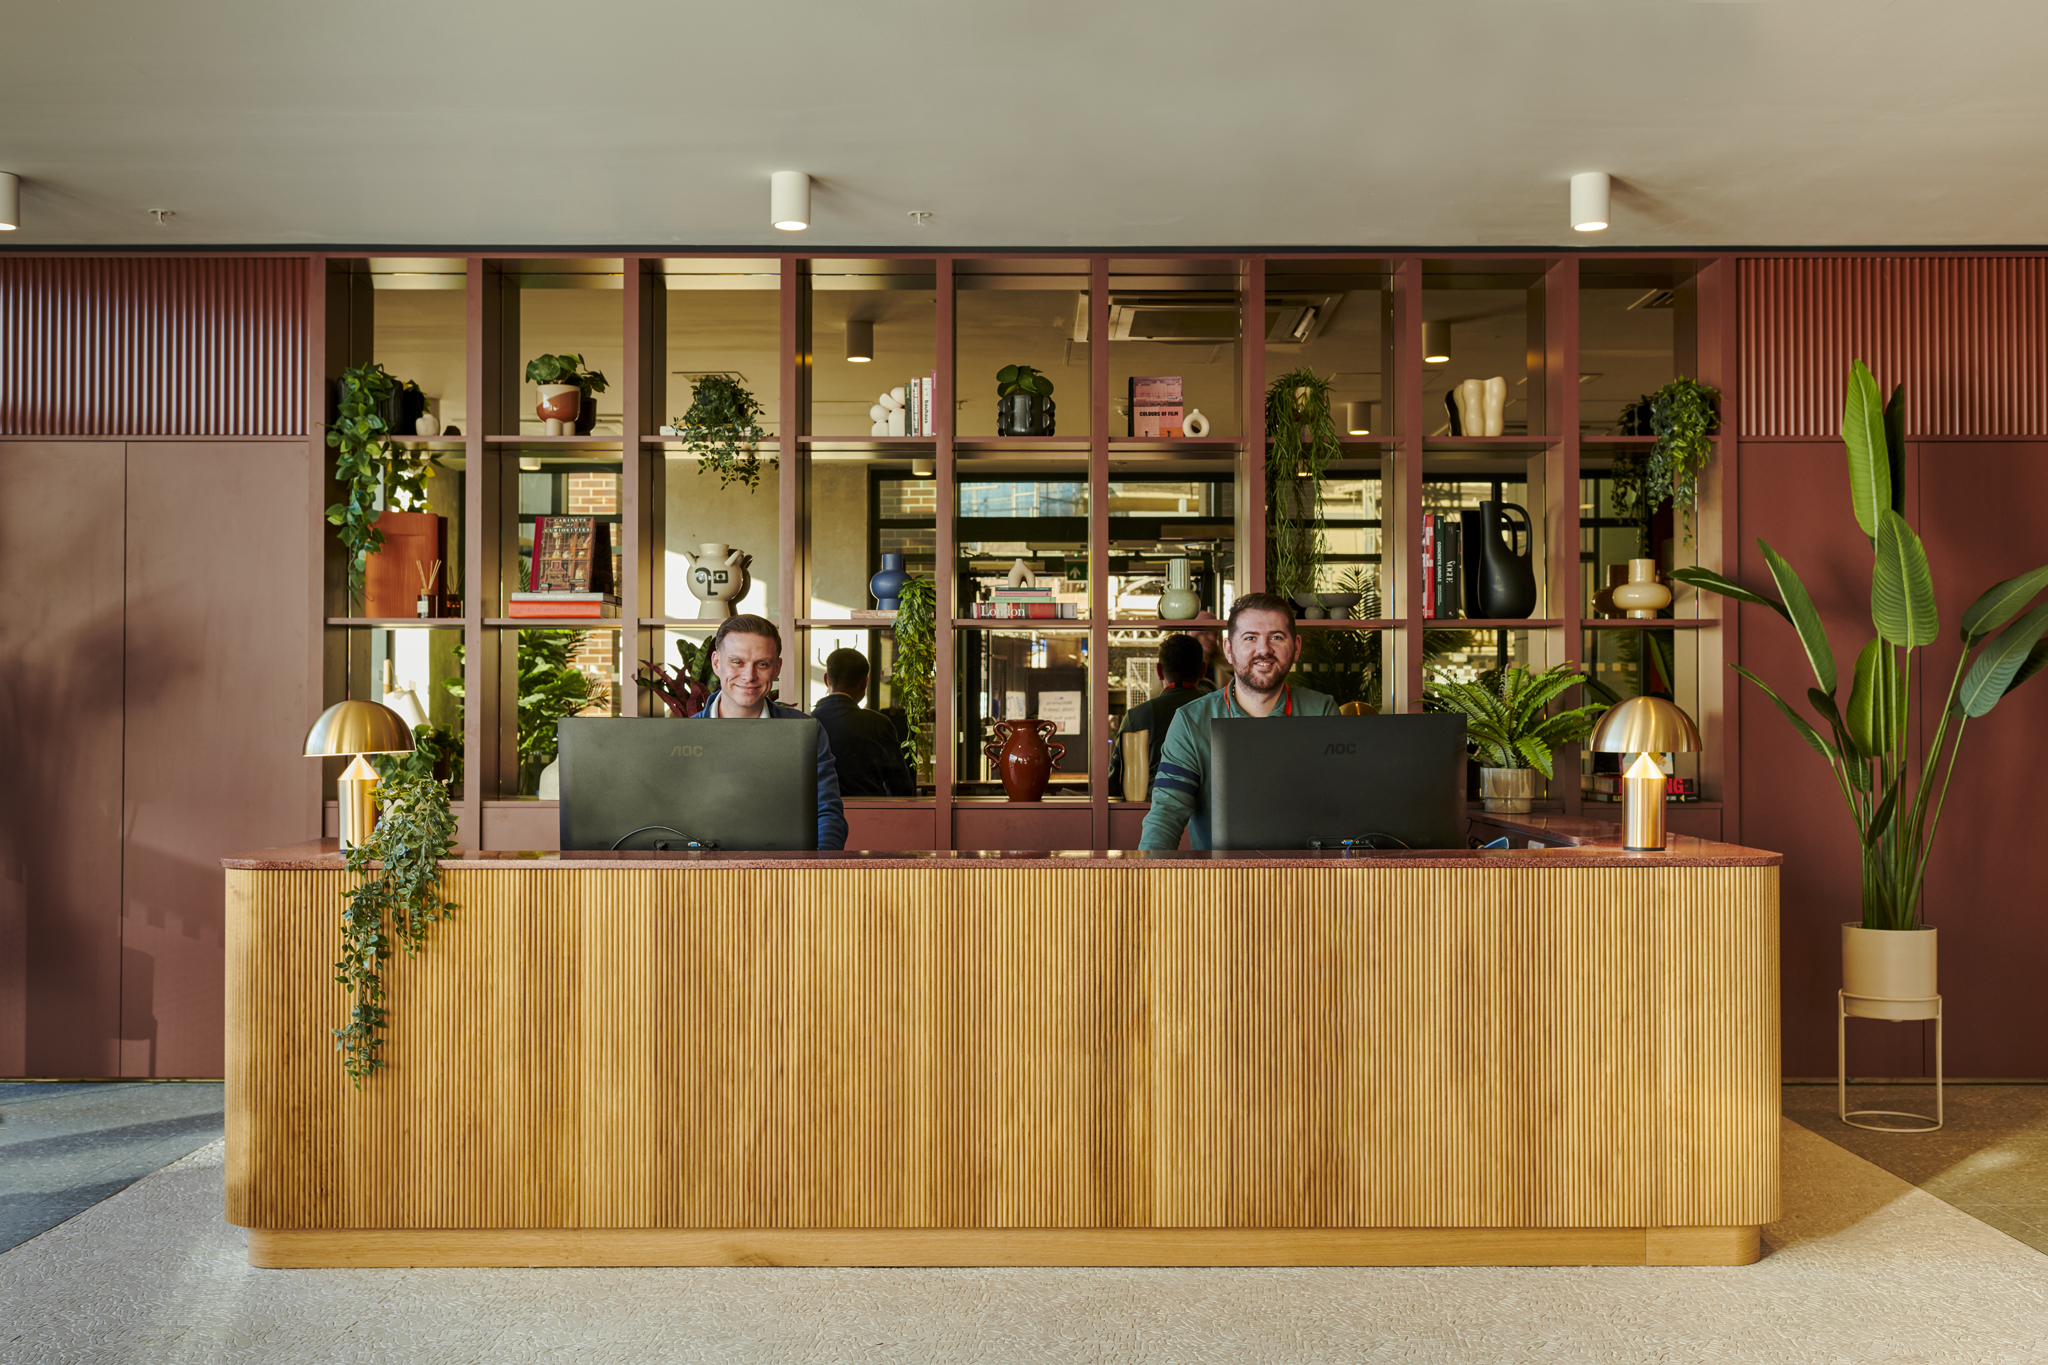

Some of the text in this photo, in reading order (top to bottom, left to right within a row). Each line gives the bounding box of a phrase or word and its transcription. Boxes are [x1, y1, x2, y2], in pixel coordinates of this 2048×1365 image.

[1446, 561, 1456, 583] VOGUE
[981, 605, 1025, 617] London
[670, 745, 704, 757] AOC
[1323, 743, 1357, 755] AOC
